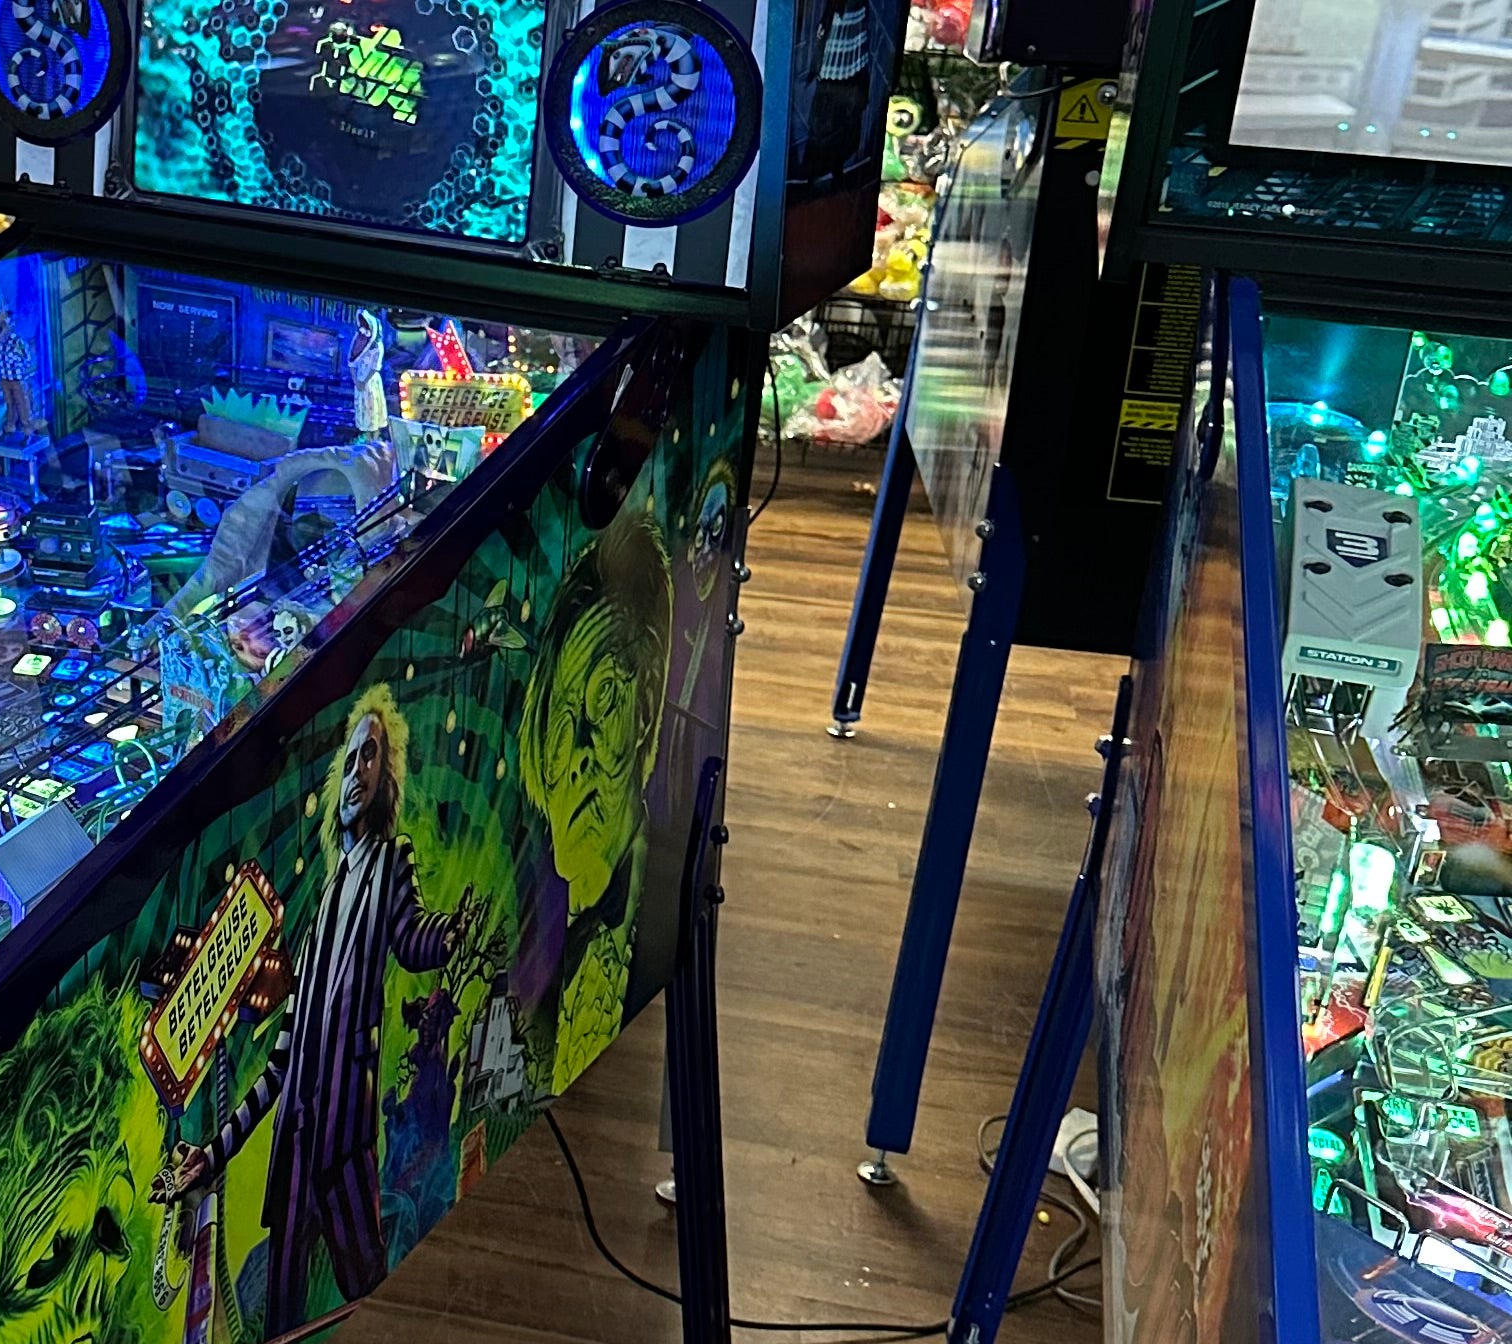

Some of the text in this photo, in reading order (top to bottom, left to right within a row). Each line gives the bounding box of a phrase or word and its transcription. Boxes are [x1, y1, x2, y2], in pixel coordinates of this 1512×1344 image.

[152, 299, 218, 319] NOW SERVING
[417, 386, 509, 410] BETELGEUSE
[1306, 648, 1389, 669] STATION 3
[168, 891, 249, 1040] BETELGEUSE
[178, 910, 259, 1062] BETELGEUSE
